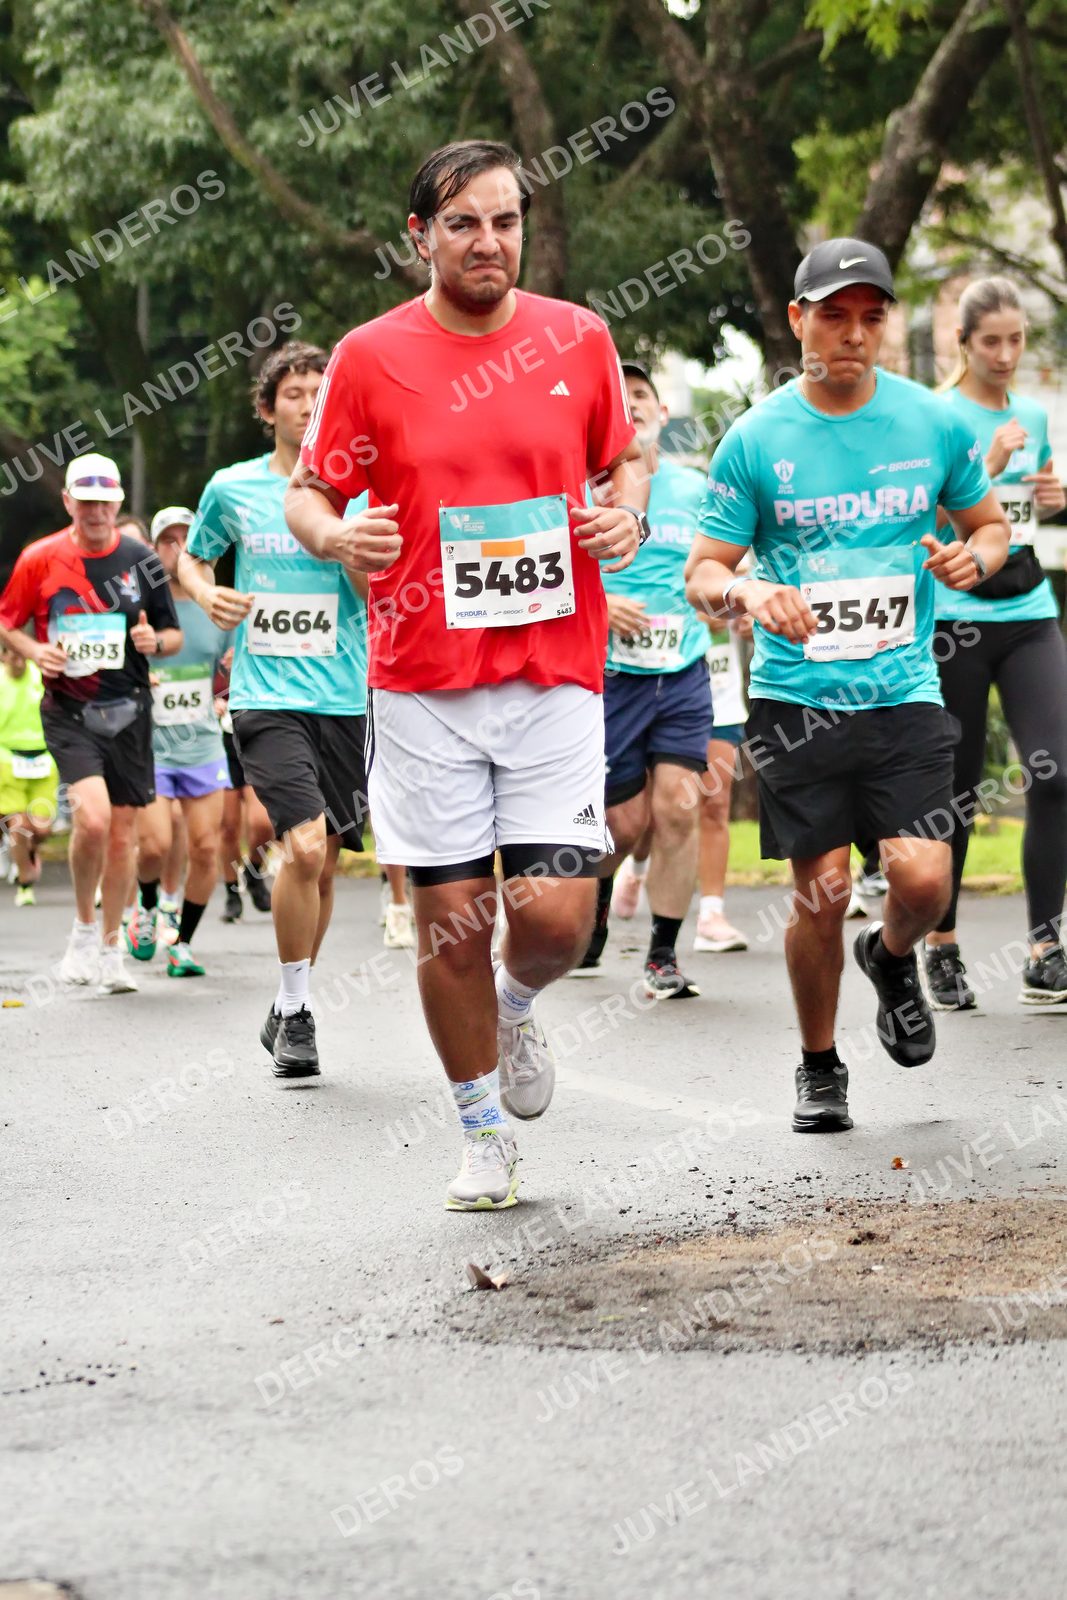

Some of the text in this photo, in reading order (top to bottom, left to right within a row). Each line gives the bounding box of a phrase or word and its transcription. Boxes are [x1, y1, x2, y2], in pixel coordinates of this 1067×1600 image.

[888, 458, 931, 472] BROOKS
[773, 484, 930, 527] PERDURA
[454, 551, 565, 599] 5483
[456, 609, 488, 618] PERDURA
[556, 607, 573, 616] 5483
[811, 596, 909, 635] 3547
[253, 608, 332, 635] 4664
[163, 691, 201, 710] 645
[573, 818, 598, 826] adidas
